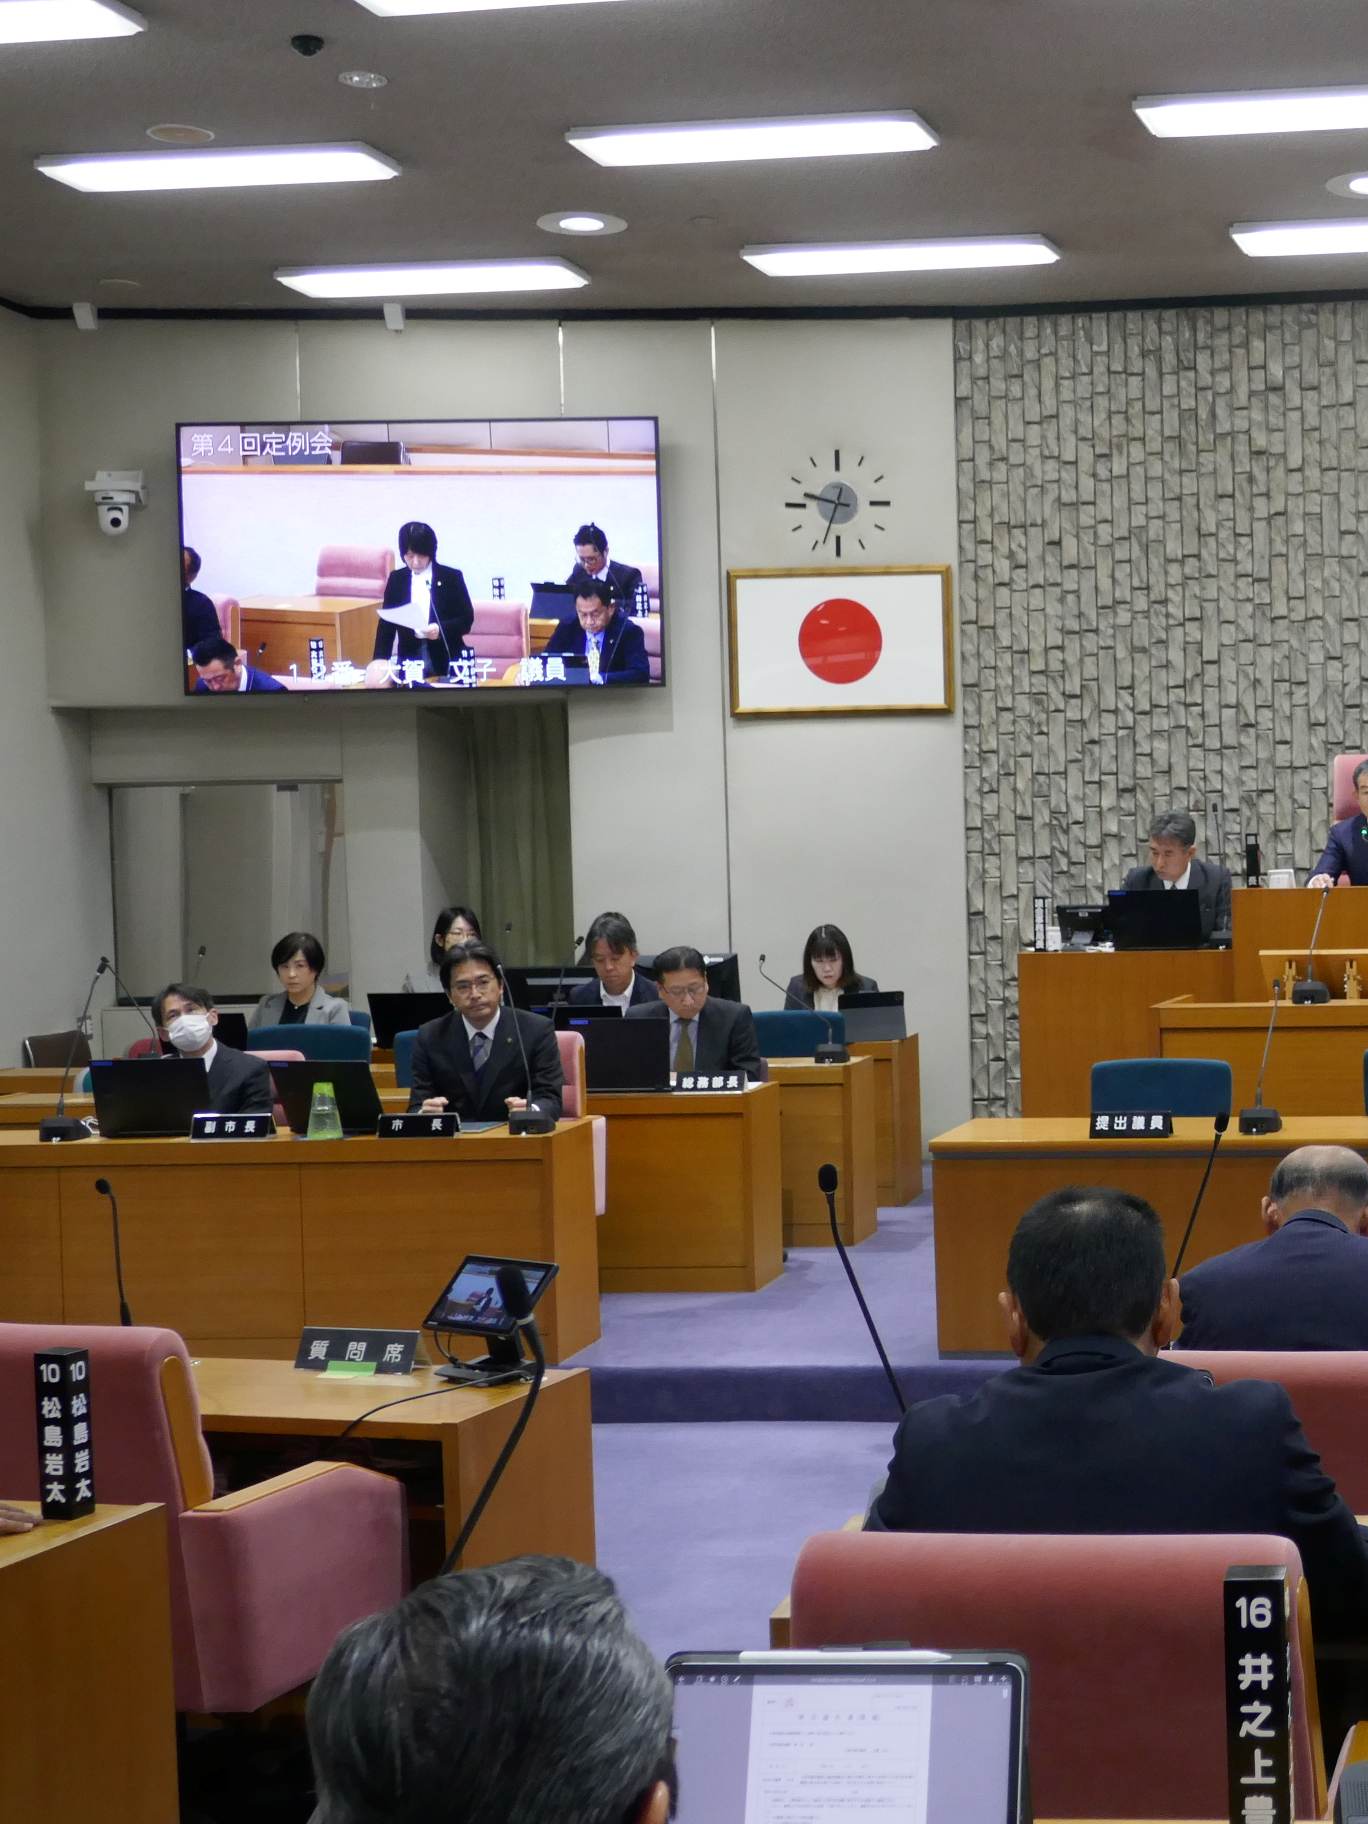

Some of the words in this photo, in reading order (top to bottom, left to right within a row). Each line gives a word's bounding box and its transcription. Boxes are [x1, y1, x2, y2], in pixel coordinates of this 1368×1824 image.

[191, 431, 333, 457] 第4回定例会
[380, 658, 426, 684] 大賀
[520, 655, 567, 682] 議員
[203, 1120, 256, 1134] 副市長
[391, 1119, 443, 1131] 市長
[1095, 1115, 1164, 1131] 提出議員
[307, 1340, 405, 1363] 質問席
[40, 1363, 61, 1383] 10
[70, 1360, 86, 1382] 10
[41, 1396, 66, 1504] 松島岩太
[71, 1392, 92, 1502] 松島岩太
[1235, 1596, 1273, 1629] 16
